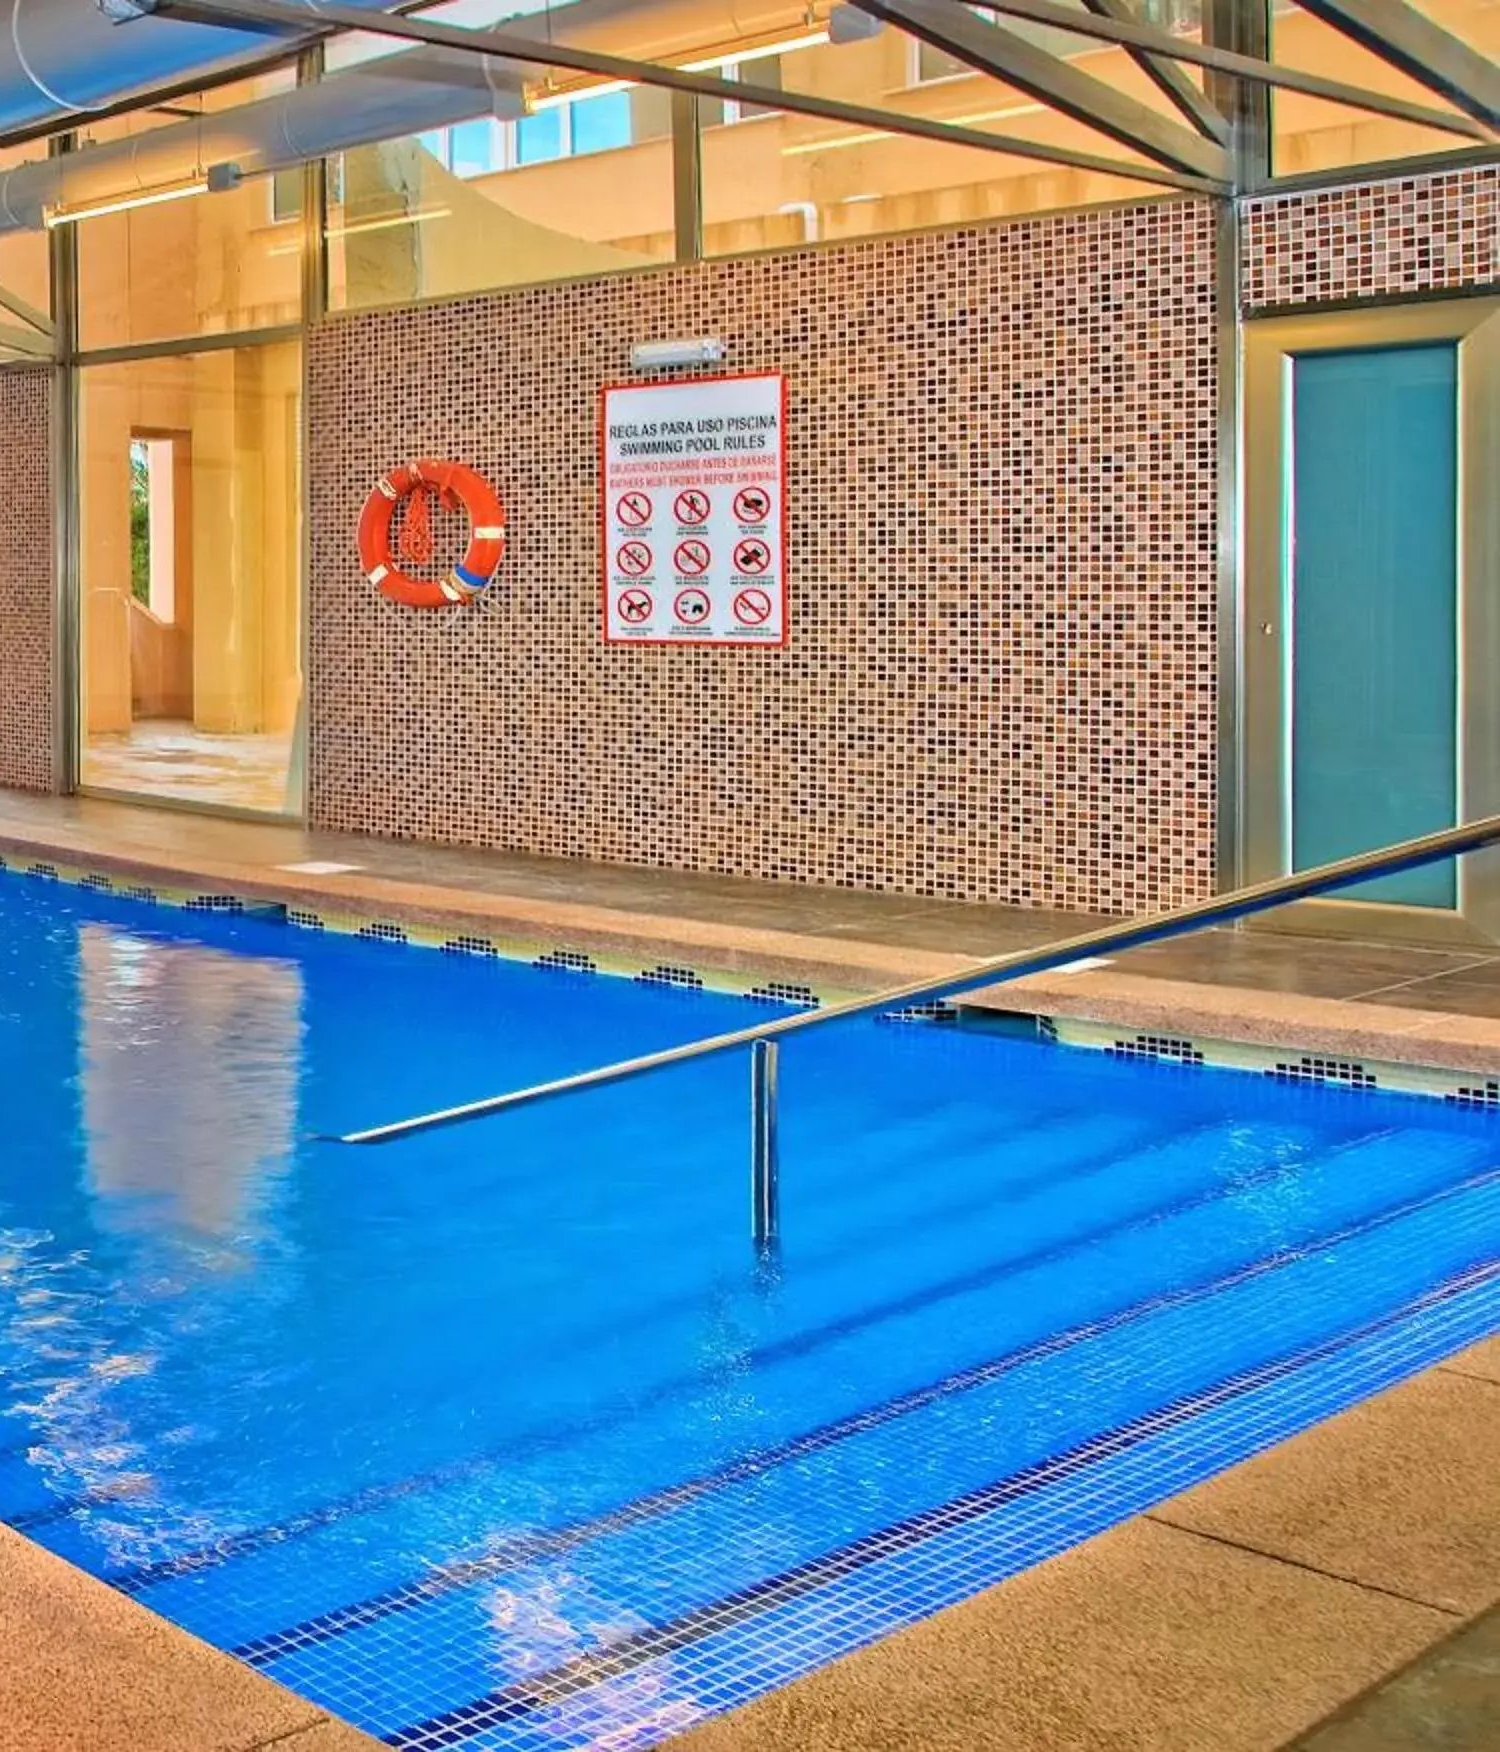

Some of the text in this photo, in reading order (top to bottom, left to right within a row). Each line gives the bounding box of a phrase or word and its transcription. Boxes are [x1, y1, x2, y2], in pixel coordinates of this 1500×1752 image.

[610, 415, 777, 438] REGLAS PARA USO PISCINA
[620, 435, 765, 456] SWIMMING POOL RULES
[703, 458, 726, 469] ANTES
[704, 473, 733, 485] BEFORE
